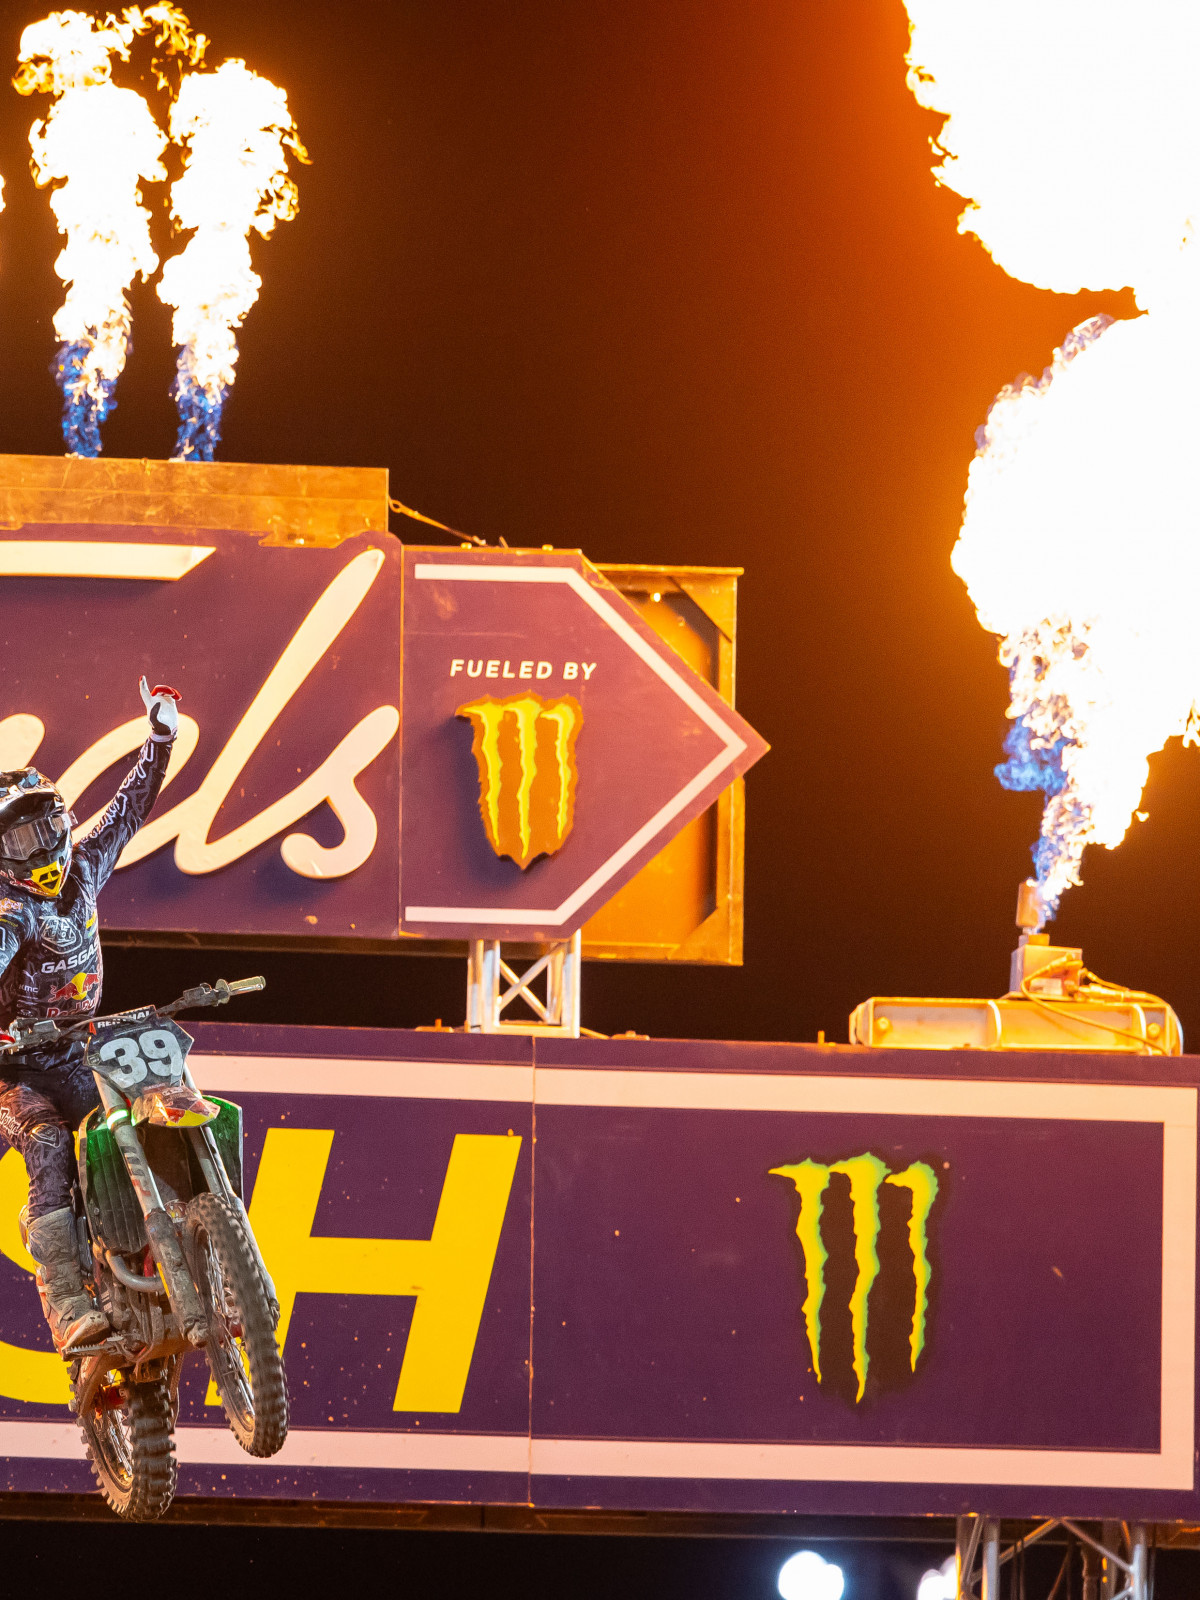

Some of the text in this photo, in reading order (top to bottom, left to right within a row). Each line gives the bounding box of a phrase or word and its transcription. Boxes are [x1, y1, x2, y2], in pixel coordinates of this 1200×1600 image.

[450, 659, 597, 680] FUELED BY
[100, 1029, 184, 1089] 39
